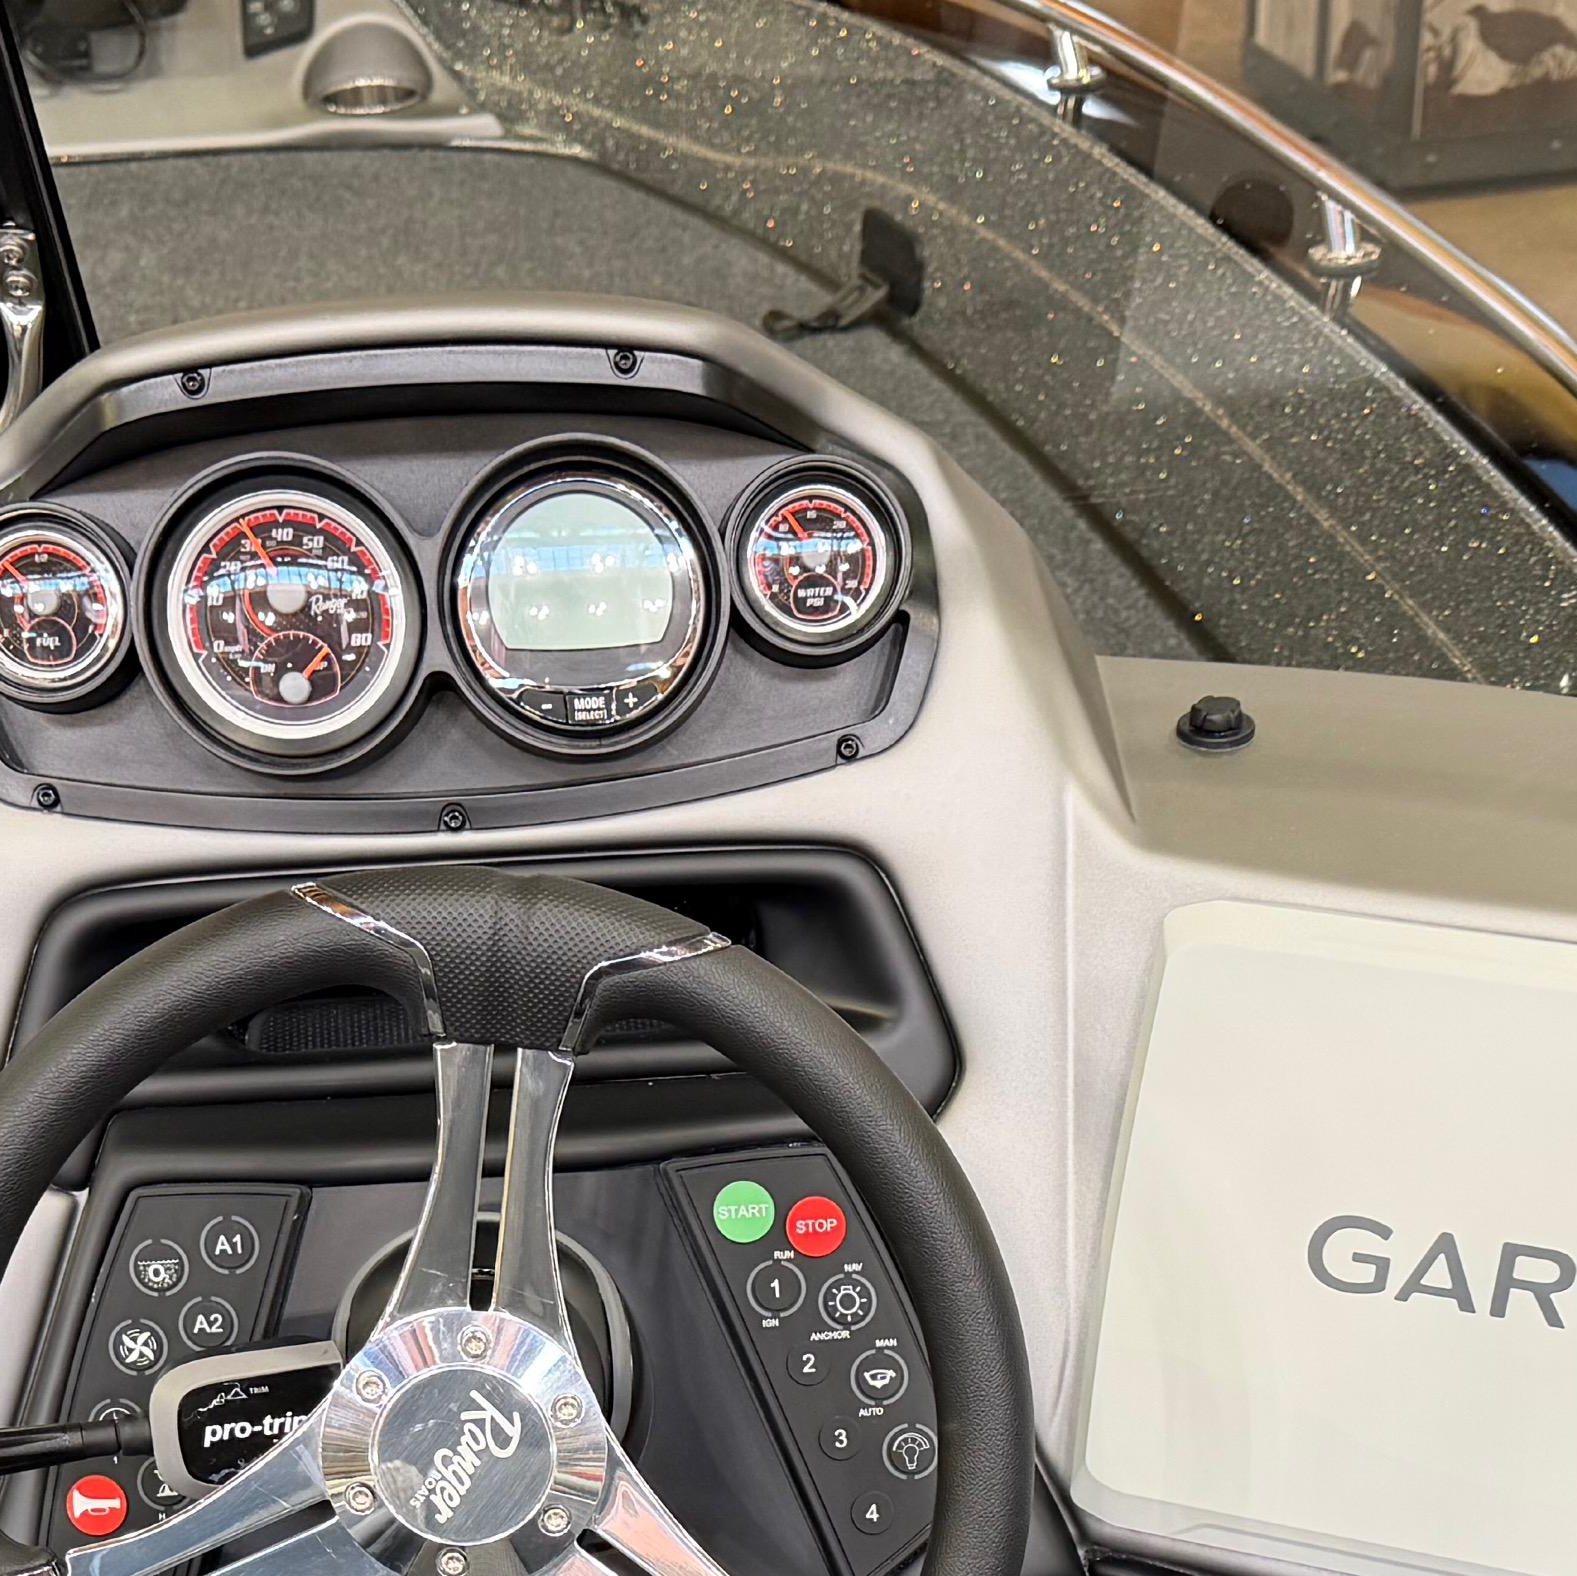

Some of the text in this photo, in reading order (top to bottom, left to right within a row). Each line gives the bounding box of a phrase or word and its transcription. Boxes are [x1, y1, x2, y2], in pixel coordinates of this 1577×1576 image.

[272, 527, 294, 542] 40
[302, 535, 324, 549] 50
[797, 586, 834, 598] WATER
[573, 696, 606, 710] MODE
[718, 1204, 769, 1220] START
[795, 1218, 838, 1234] STOP
[214, 1233, 243, 1256] A1
[774, 1250, 795, 1260] RUN
[843, 1262, 863, 1273] NAV
[769, 1278, 781, 1298] 1
[193, 1313, 224, 1334] A2
[762, 1318, 780, 1328] IGN
[809, 1330, 851, 1342] ANCHOR
[875, 1338, 898, 1348] MAN
[801, 1353, 817, 1374] 2
[858, 1406, 884, 1418] AUTO
[833, 1428, 848, 1448] 3
[429, 1389, 522, 1524] Ranger
[865, 1503, 880, 1523] 4
